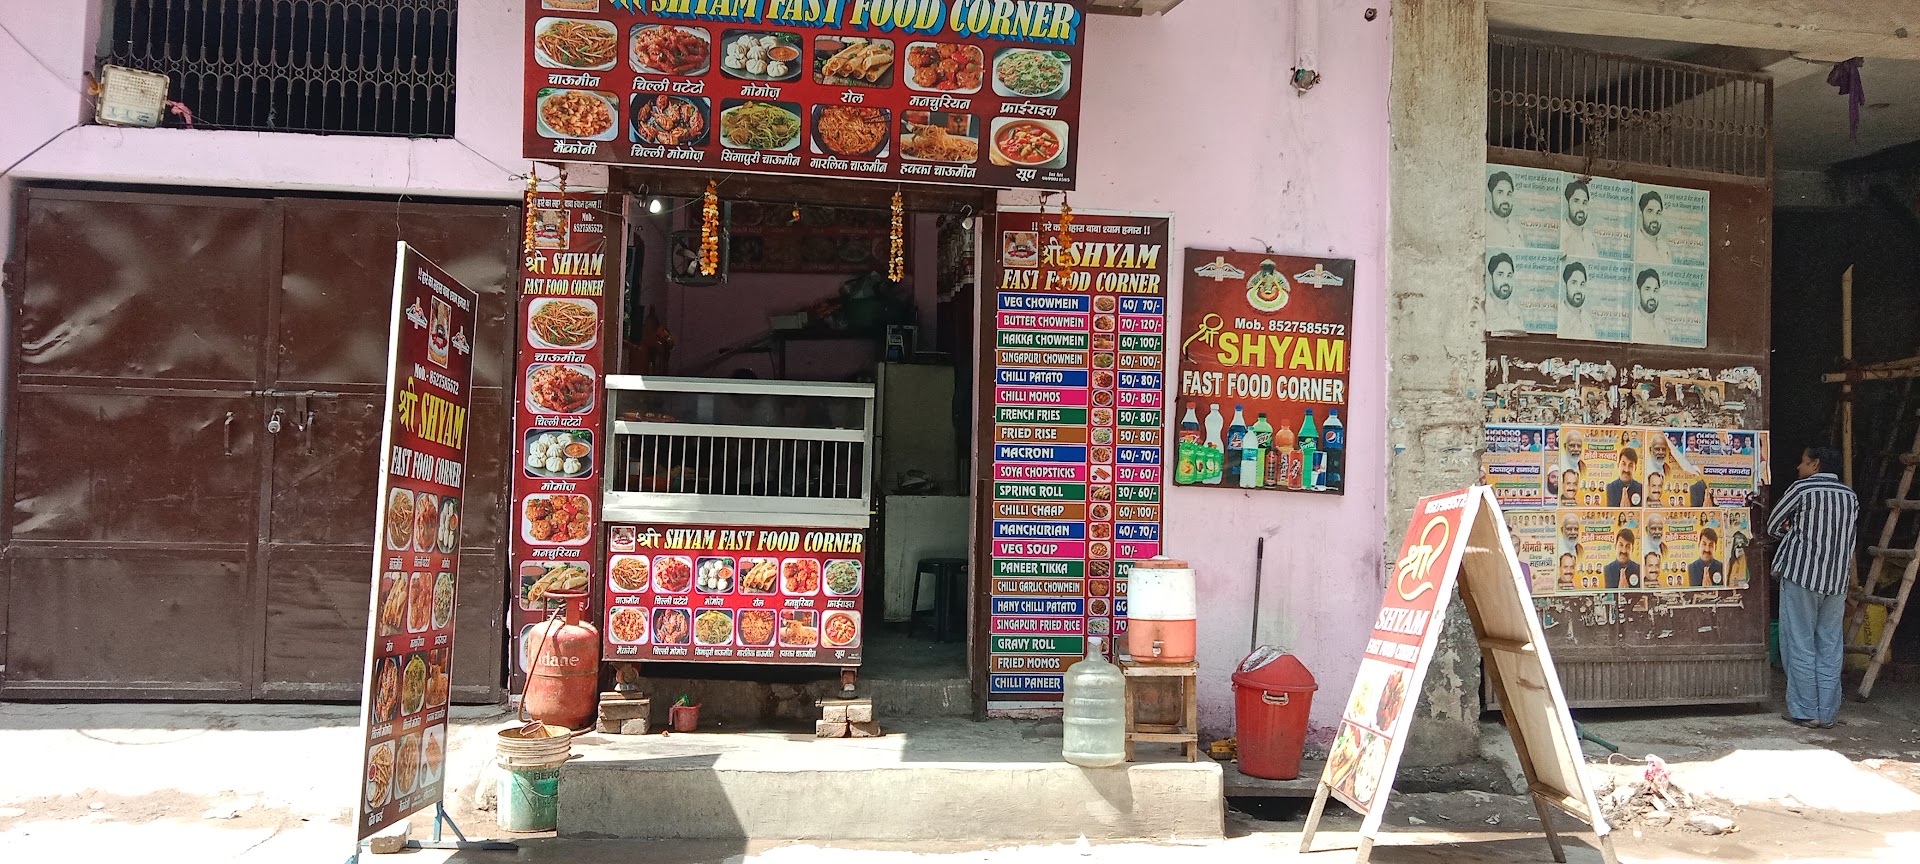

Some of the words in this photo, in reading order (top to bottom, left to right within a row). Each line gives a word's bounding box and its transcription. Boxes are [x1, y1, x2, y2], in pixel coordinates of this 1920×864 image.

[849, 0, 942, 29] FOOD
[950, 0, 1075, 40] CORNER
[548, 73, 600, 87] चाऊमीन
[632, 77, 669, 92] चिल्ली
[672, 79, 705, 94] पटेटो
[841, 90, 864, 104] रोल
[909, 94, 971, 111] मनचुरियन
[631, 144, 665, 158] चिल्ली
[720, 149, 759, 165] सिंगापुरी
[762, 152, 801, 166] चाऊमीन
[810, 157, 848, 170] गारलिक
[850, 159, 888, 172] चाऊमीन
[934, 165, 976, 178] चाऊमीन
[1015, 168, 1037, 181] सूप
[1070, 241, 1161, 269] SHYAM
[551, 253, 604, 275] SHYAM
[524, 278, 544, 294] FAST
[545, 279, 569, 295] FOOD
[571, 280, 605, 296] CORNER
[1001, 269, 1039, 289] FAST
[1096, 272, 1160, 293] CORNER
[1004, 297, 1023, 307] VEG
[1026, 298, 1079, 309] CHOWMEIN
[1122, 300, 1138, 312] 40/
[1143, 300, 1160, 313] 70/-
[1004, 315, 1036, 327] BUTTER
[1038, 317, 1084, 328] CHOWMEIN
[1121, 319, 1139, 331] 70/-
[1140, 319, 1162, 331] 120/-
[1235, 318, 1265, 331] Mob.
[1269, 320, 1345, 336] 8527585572
[1003, 334, 1033, 345] HAKKA
[1036, 334, 1084, 346] CHOWMEIN
[1122, 337, 1138, 349] 60/-
[1140, 338, 1161, 350] 100/-
[535, 351, 586, 362] चाऊमीन
[1002, 352, 1041, 364] SINGAPURI
[1043, 353, 1083, 365] CHOWMEIN
[1217, 332, 1346, 373] SHYAM
[1121, 356, 1138, 368] 60/-
[1139, 356, 1160, 368] 100/-
[1001, 371, 1027, 383] CHILLI
[1029, 372, 1063, 383] PATATO
[1121, 374, 1139, 386] 50/-
[1141, 375, 1159, 387] 80/-
[1182, 370, 1223, 396] FAST
[1227, 373, 1273, 399] FOOD
[1277, 376, 1344, 405] CORNER
[1001, 391, 1027, 402] CHILLI
[1029, 391, 1061, 403] MOMOS
[1121, 393, 1138, 405] 50/-
[1140, 393, 1159, 405] 80/-
[399, 376, 418, 433] श्री
[418, 392, 466, 450] SHYAM
[1000, 409, 1034, 421] FRENCH
[1036, 409, 1061, 421] FRIES
[1121, 411, 1138, 423] 50/-
[1140, 412, 1159, 424] 80/-
[535, 415, 559, 426] चिल्ली
[1001, 428, 1032, 439] FRIED
[1034, 428, 1057, 440] RISE
[1120, 430, 1138, 442] 50/-
[1140, 431, 1159, 443] 80/-
[1001, 448, 1054, 459] MACRONI
[1121, 449, 1139, 461] 40/-
[1141, 450, 1158, 462] 70/-
[390, 445, 412, 477] FAST
[411, 451, 434, 482] FOOD
[435, 457, 461, 488] CORNER
[1000, 467, 1023, 477] SOYA
[1025, 467, 1076, 479] CHOPSTICKS
[1120, 468, 1138, 481] 30/-
[1140, 469, 1158, 481] 60/-
[1000, 485, 1036, 497] SPRING
[1039, 486, 1063, 497] ROLL
[1118, 487, 1136, 499] 30/-
[1138, 488, 1156, 500] 60/-
[1000, 504, 1029, 516] CHILLI
[1031, 505, 1064, 516] CHAAP
[1119, 506, 1135, 518] 60/-
[1137, 507, 1157, 519] 100/-
[1000, 524, 1070, 537] MANCHURIAN
[1119, 526, 1137, 538] 40/-
[1138, 526, 1156, 538] 70/-
[637, 528, 662, 548] श्री
[664, 529, 716, 550] SHYAM
[718, 529, 755, 550] FAST
[757, 531, 800, 551] FOOD
[804, 532, 863, 553] CORNER
[1001, 543, 1023, 555] VEG
[1026, 544, 1058, 555] SOUP
[1121, 545, 1138, 558] 10/-
[1000, 562, 1038, 574] PANEER
[1040, 563, 1068, 574] TIKKA
[998, 581, 1018, 592] CHILLI
[1019, 582, 1042, 592] GARLIC
[1045, 582, 1080, 593] CHOWMEIN
[998, 600, 1019, 612] HANY
[1021, 601, 1044, 613] CHILLI
[1046, 601, 1076, 613] PATATO
[997, 620, 1037, 631] SINGAPURI
[1039, 620, 1062, 631] FRIED
[1064, 620, 1080, 631] RICE
[1374, 607, 1430, 636] SHYAM
[998, 639, 1029, 650] GRAVY
[1032, 639, 1055, 650] ROLL
[998, 658, 1025, 669] FRIED
[1027, 658, 1060, 669] MOMOS
[995, 677, 1022, 688] CHILLI
[1024, 677, 1060, 689] PANEER
